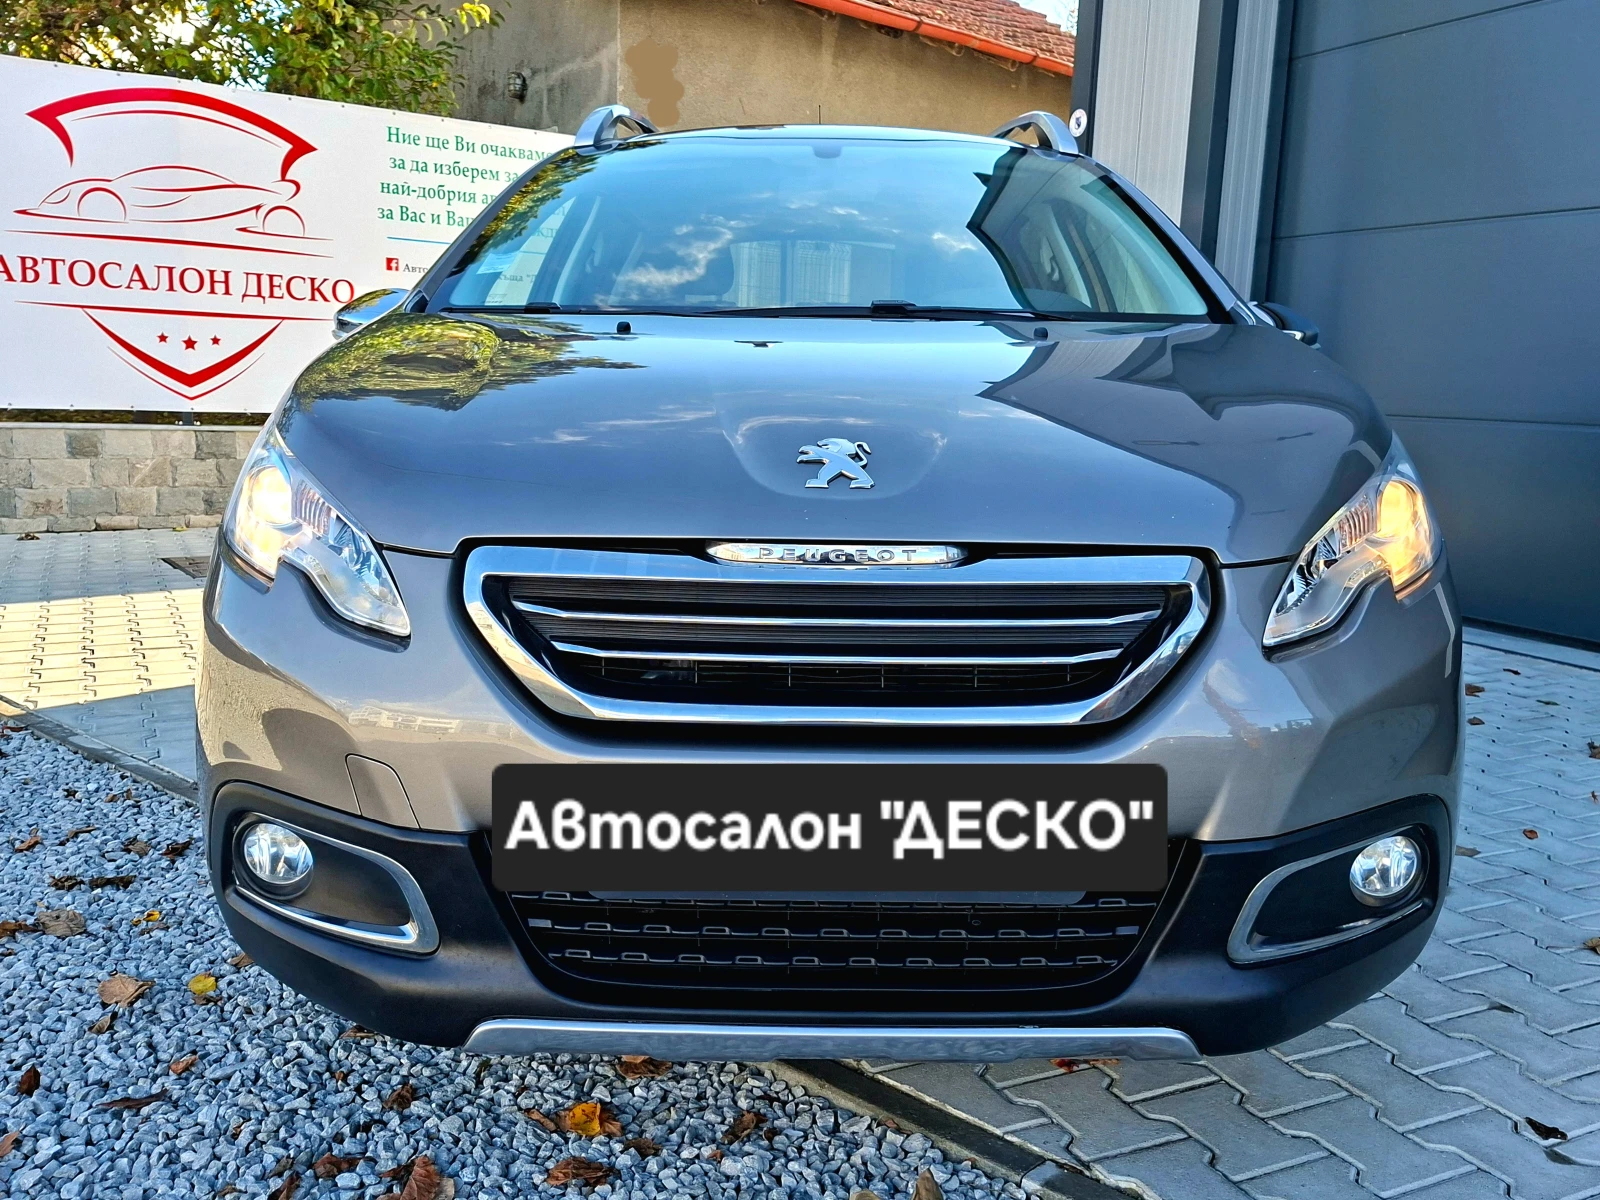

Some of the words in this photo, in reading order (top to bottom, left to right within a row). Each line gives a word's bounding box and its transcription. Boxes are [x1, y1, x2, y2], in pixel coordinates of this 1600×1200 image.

[386, 126, 421, 146] Ние
[425, 136, 450, 151] ще
[454, 135, 476, 153] Ви
[389, 157, 406, 170] за
[410, 159, 429, 174] да
[433, 161, 500, 183] изберем
[380, 181, 477, 206] най-добрия
[377, 207, 394, 220] за
[399, 205, 426, 223] Вас
[430, 213, 441, 225] и
[241, 271, 355, 304] ДЕСКО
[758, 546, 918, 562] PEUGEOT
